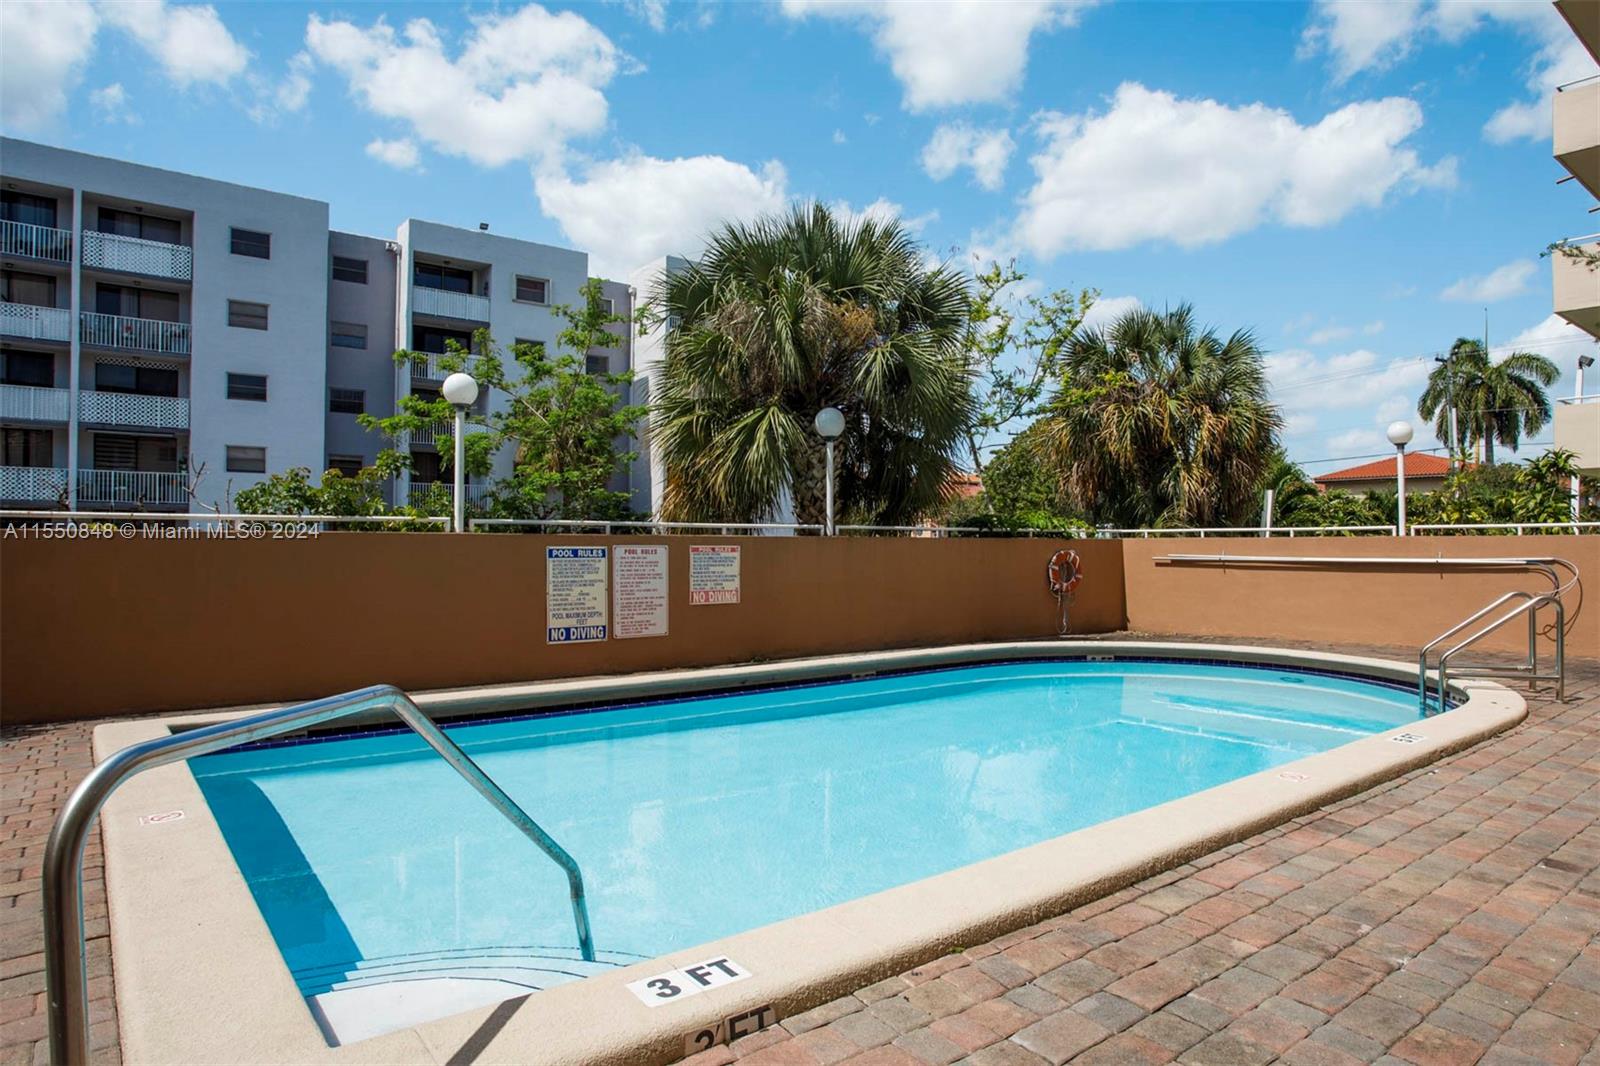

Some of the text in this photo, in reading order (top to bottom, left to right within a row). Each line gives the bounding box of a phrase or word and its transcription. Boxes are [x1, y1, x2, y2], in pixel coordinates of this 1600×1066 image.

[552, 549, 603, 557] POOL RULES
[693, 590, 737, 602] NO DIVING
[551, 626, 604, 641] NO DIVING
[647, 958, 739, 998] 3 FT
